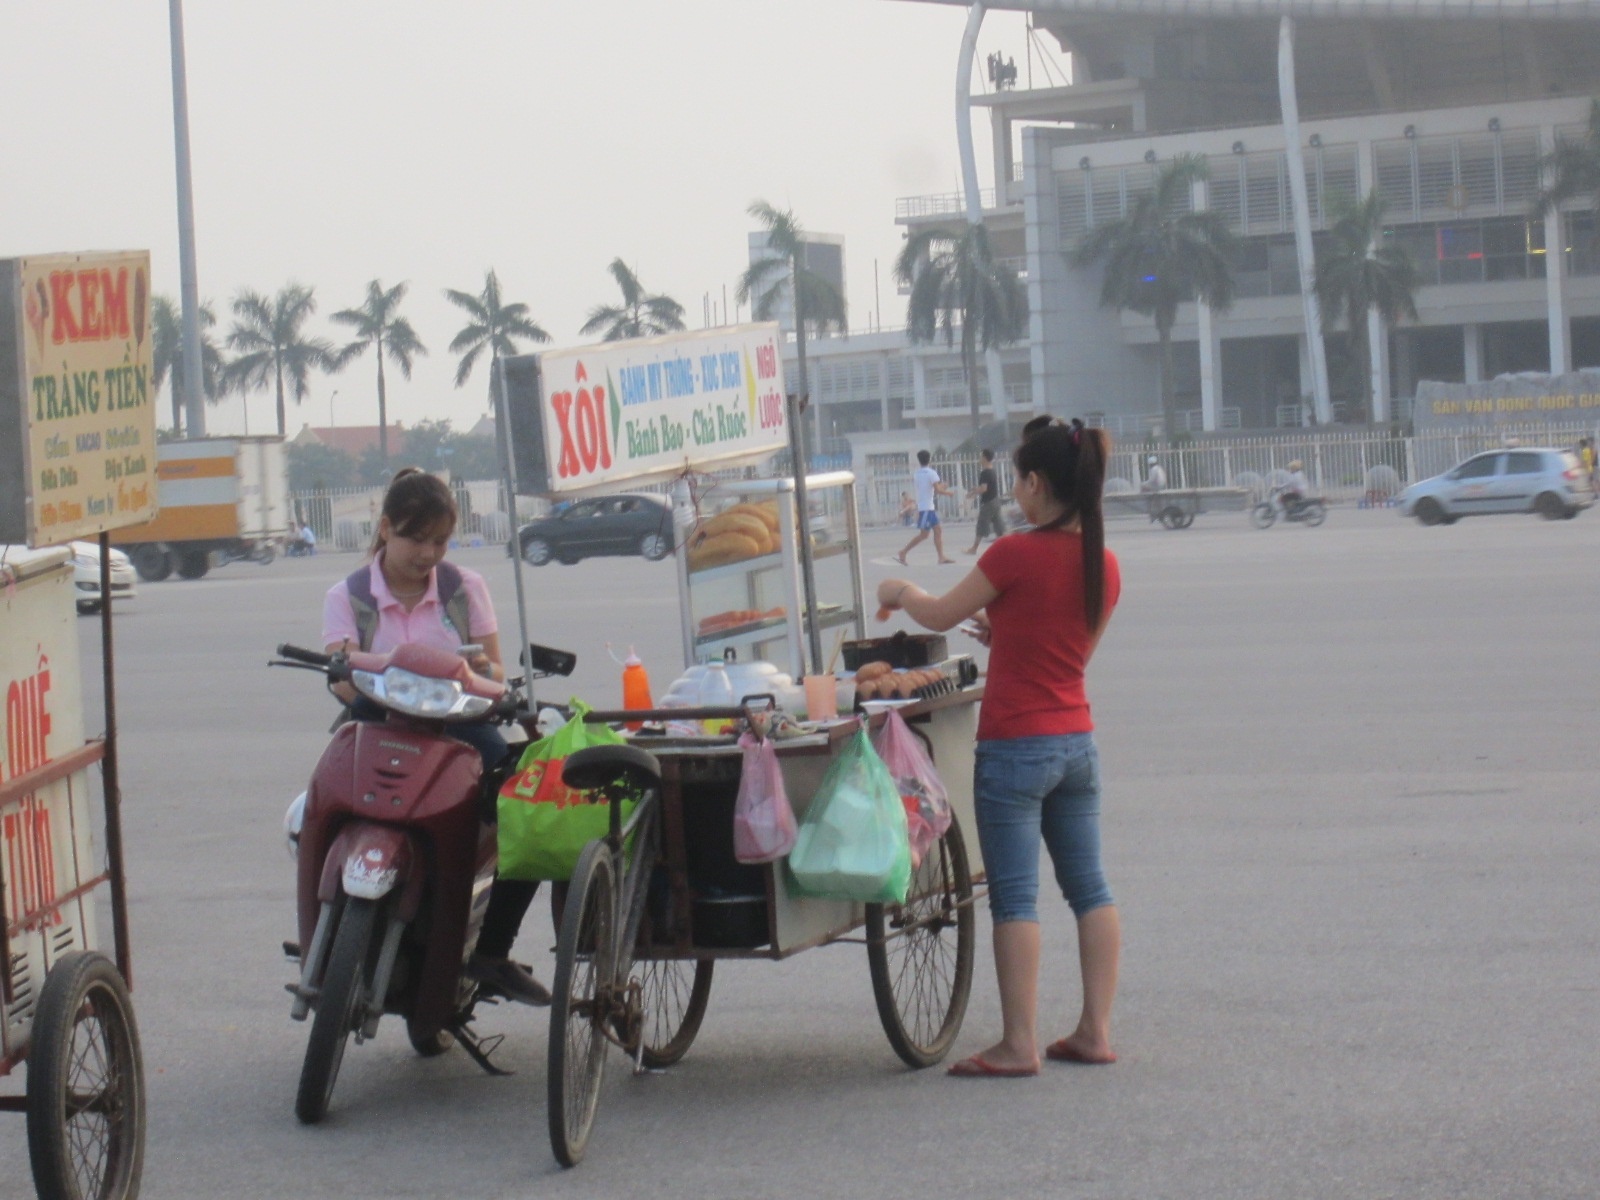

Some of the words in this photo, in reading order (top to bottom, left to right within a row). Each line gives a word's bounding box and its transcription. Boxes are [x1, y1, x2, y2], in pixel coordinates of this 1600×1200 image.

[49, 266, 130, 345] KEM
[551, 359, 611, 478] XÔI
[625, 417, 660, 459] Bánh
[660, 414, 684, 450] Bao
